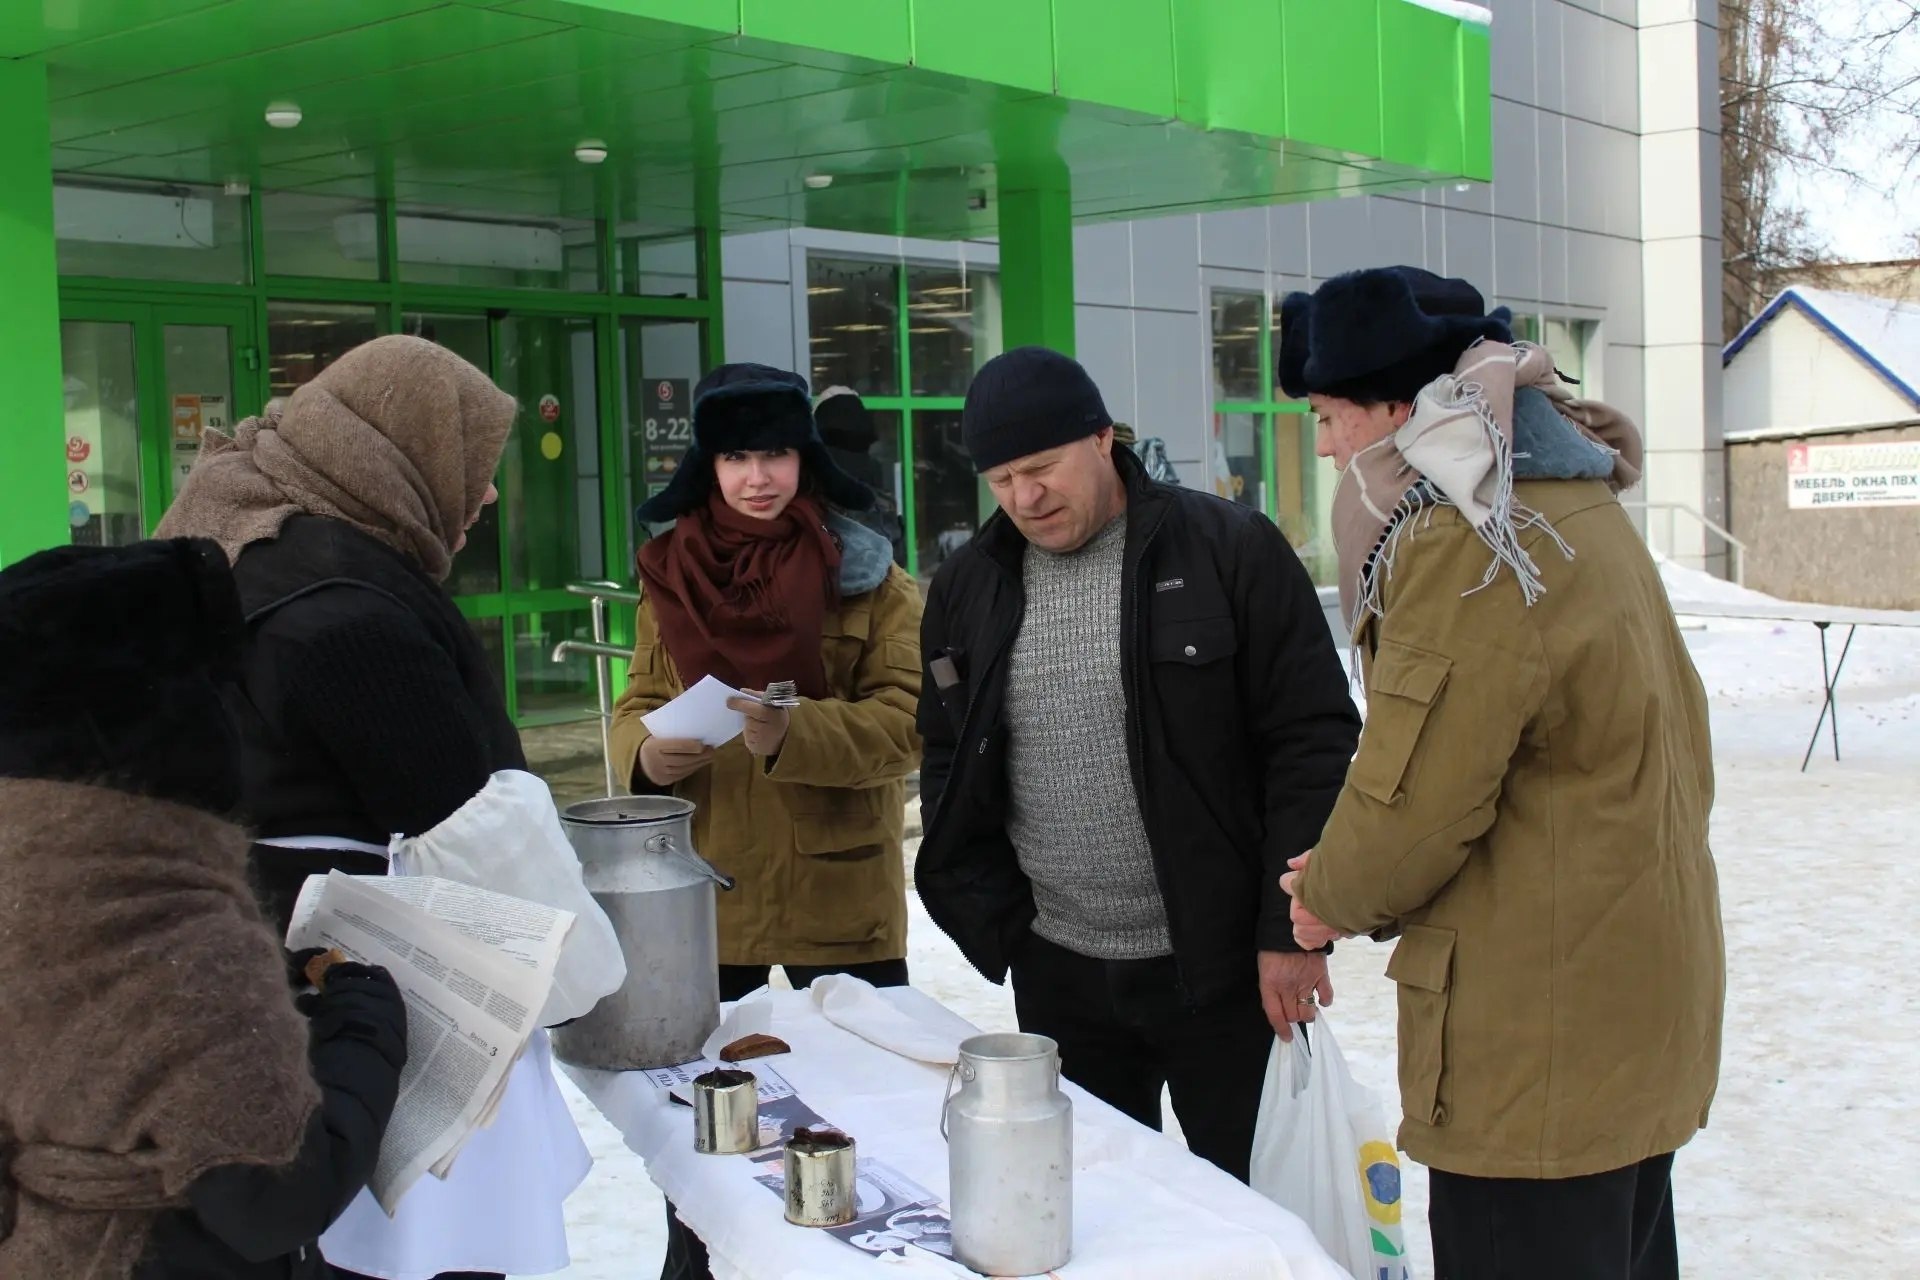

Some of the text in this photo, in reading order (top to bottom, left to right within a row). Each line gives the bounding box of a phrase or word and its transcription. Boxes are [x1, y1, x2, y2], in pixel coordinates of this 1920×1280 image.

[646, 418, 690, 440] 8-22
[1795, 474, 1918, 489] МЕБЕЛЬ ОКНА ПВХ
[1812, 492, 1854, 504] ДВЕРИ
[490, 1046, 498, 1057] 3
